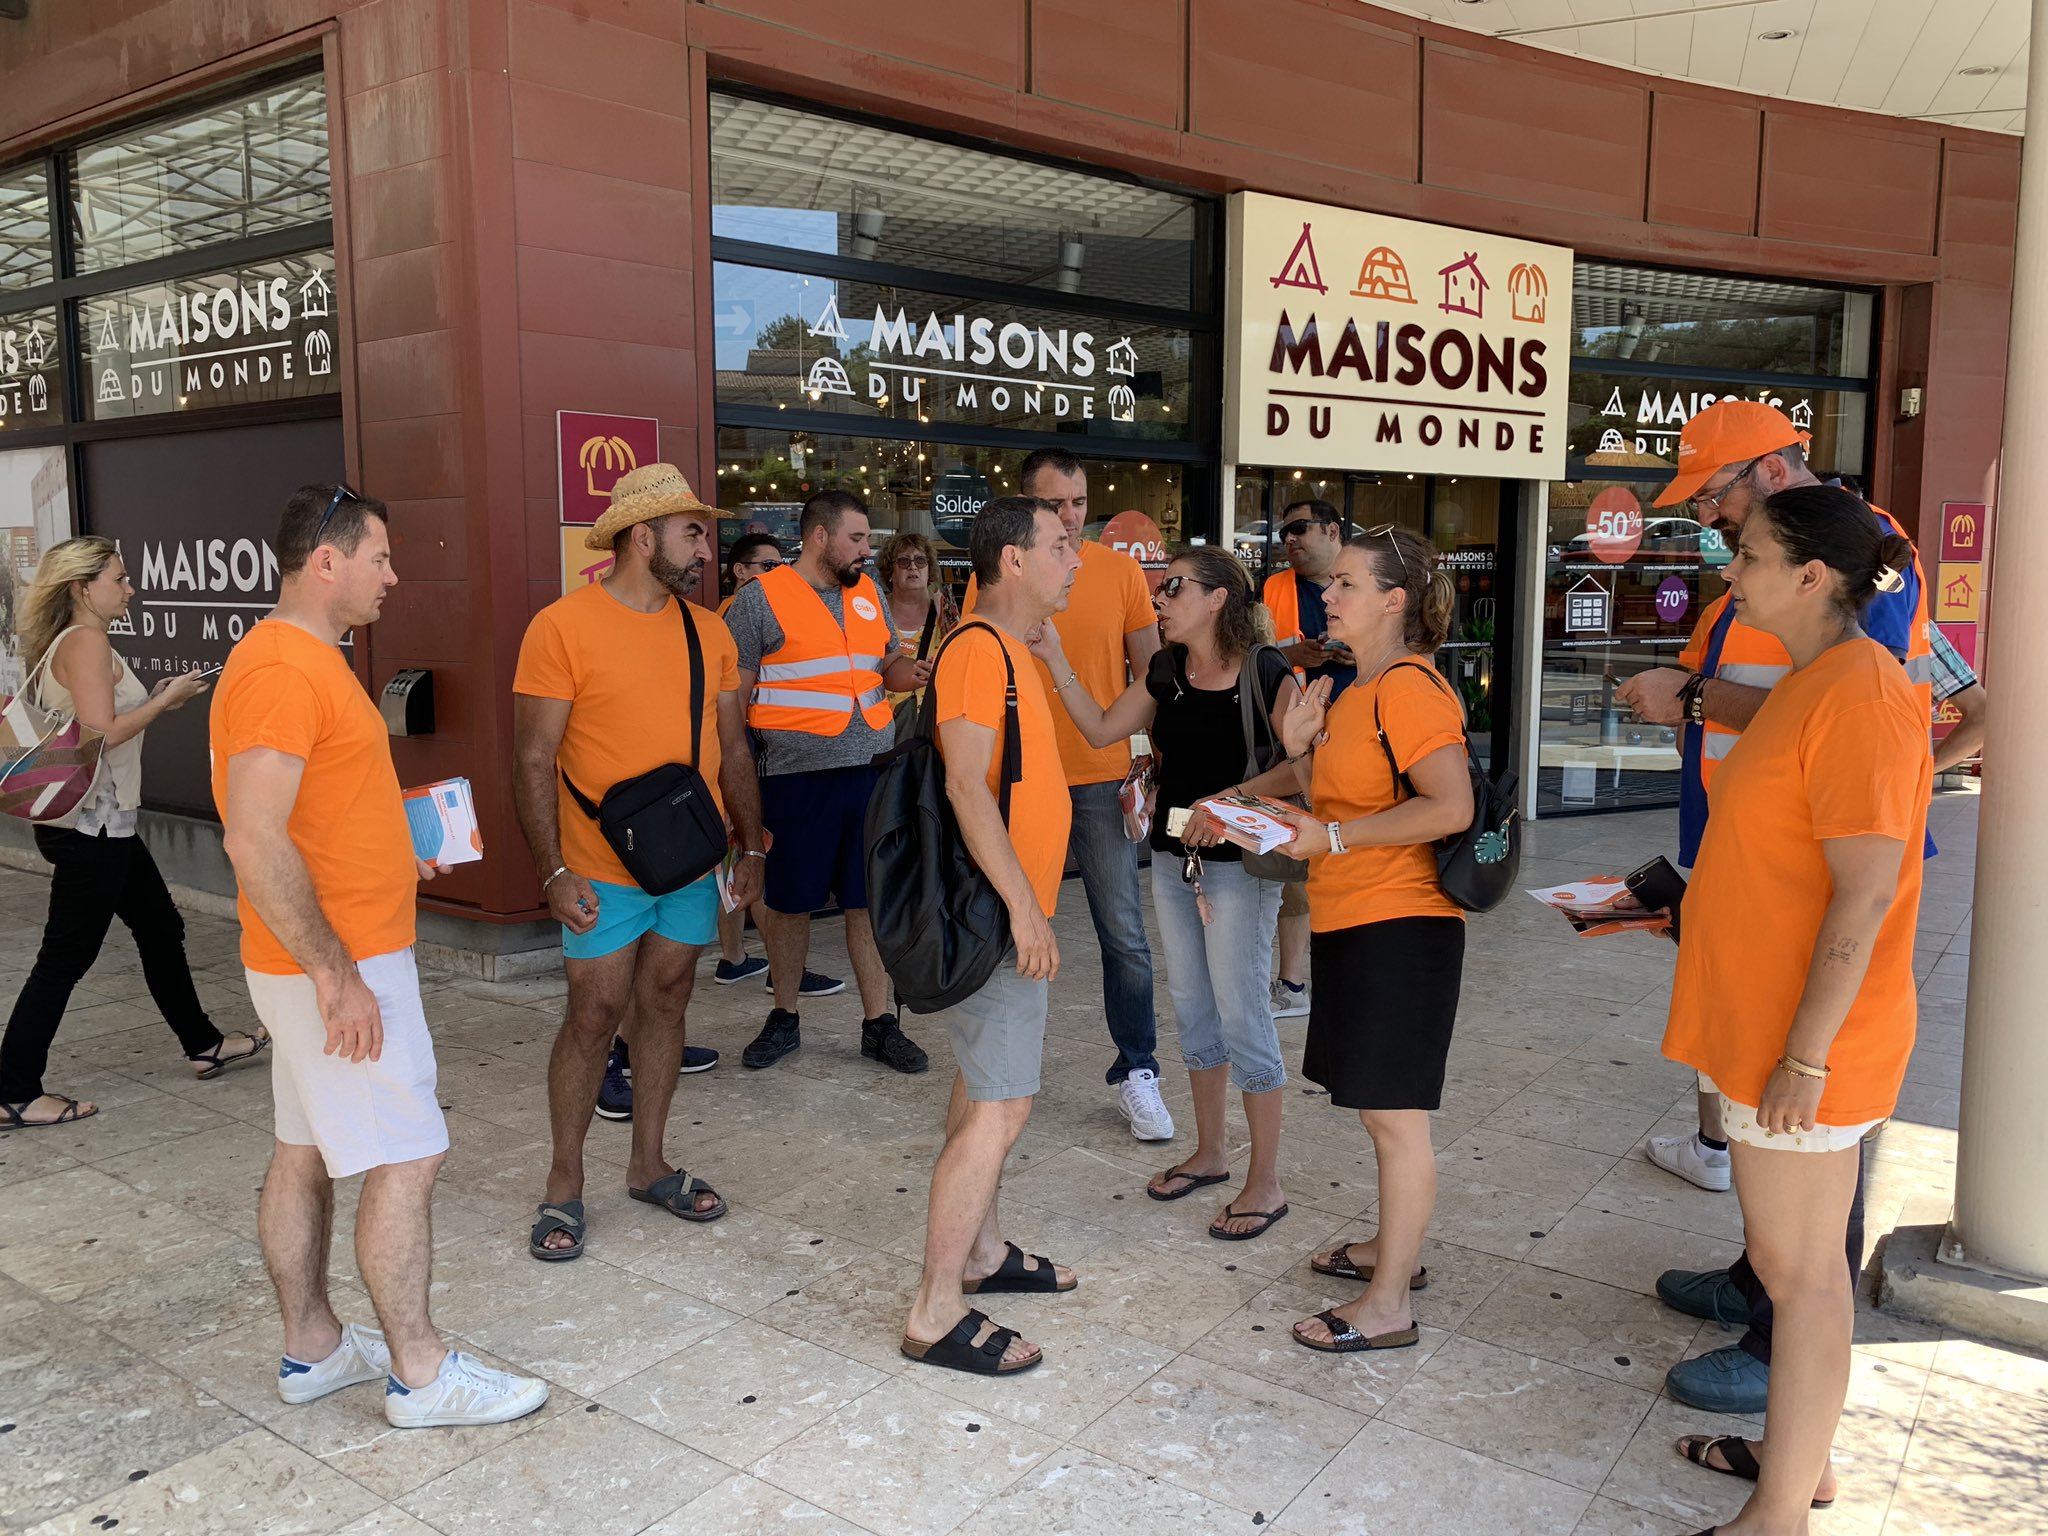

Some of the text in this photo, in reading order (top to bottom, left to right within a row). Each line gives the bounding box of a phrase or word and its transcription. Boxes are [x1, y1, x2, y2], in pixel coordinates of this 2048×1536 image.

[129, 277, 291, 353] MAISONS
[868, 303, 1096, 378] MAISONS
[1268, 308, 1548, 398] MAISONS
[131, 352, 294, 399] DU MONDE
[868, 372, 1095, 420] DU MONDE
[1267, 403, 1545, 454] DU MONDE
[1635, 437, 1668, 455] DU
[1587, 511, 1642, 539] -50%
[1447, 552, 1485, 561] MAISONS
[1656, 590, 1688, 608] -70%
[142, 611, 177, 639] DU
